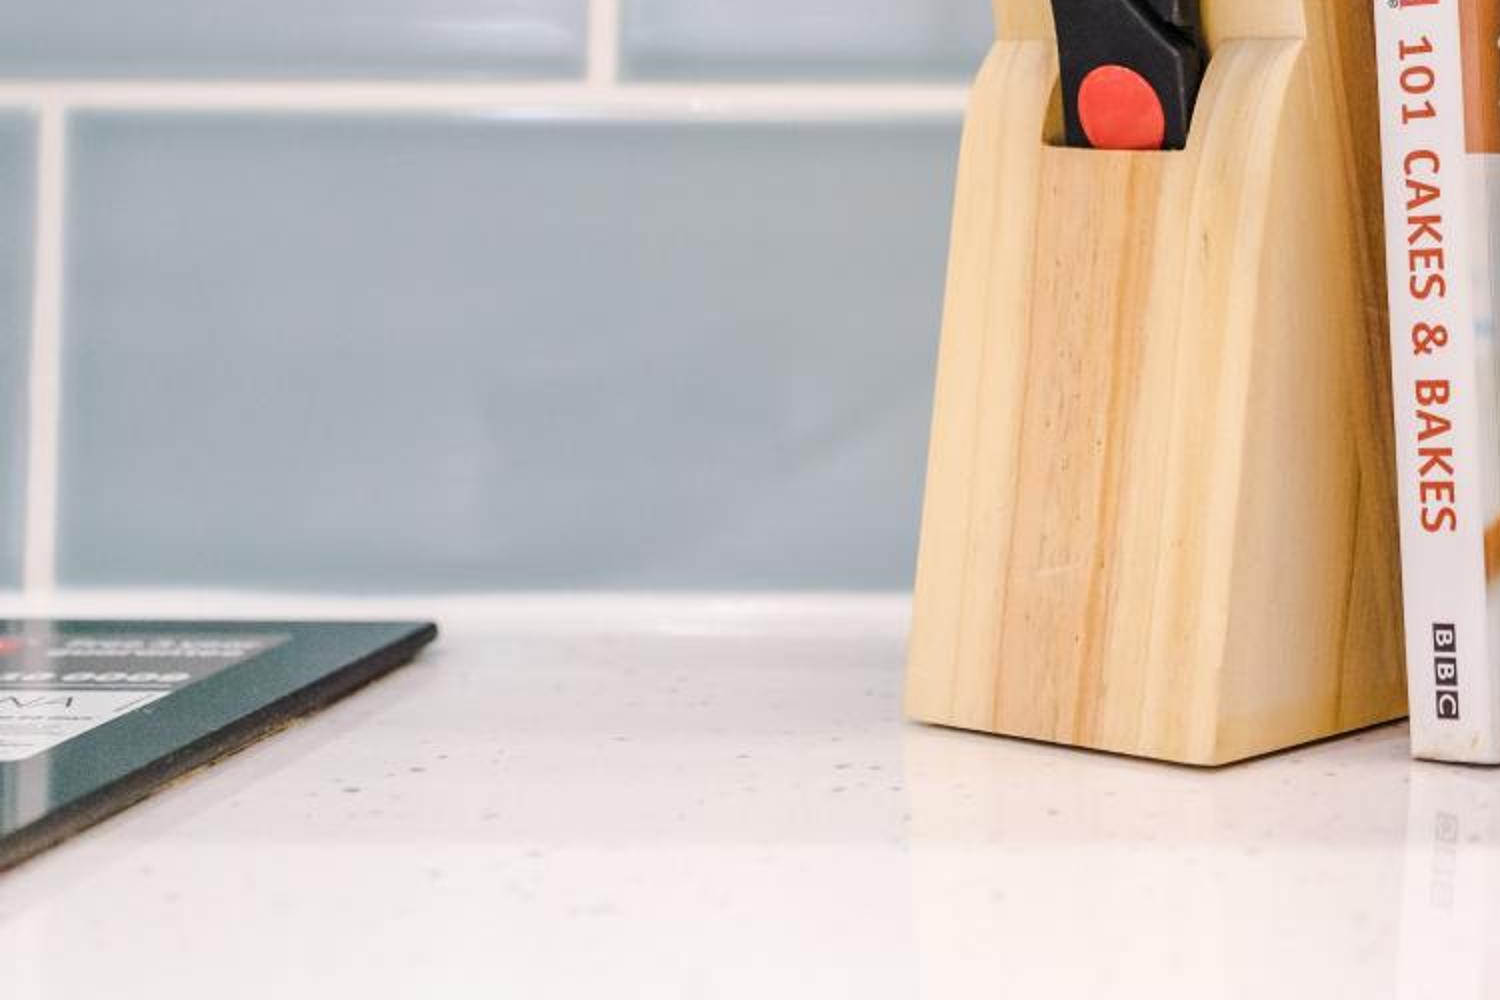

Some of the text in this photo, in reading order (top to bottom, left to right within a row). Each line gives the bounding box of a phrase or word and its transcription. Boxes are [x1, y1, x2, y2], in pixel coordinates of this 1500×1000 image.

[1398, 35, 1457, 534] 101 CAKES & BAKES
[1432, 623, 1459, 721] BBC
